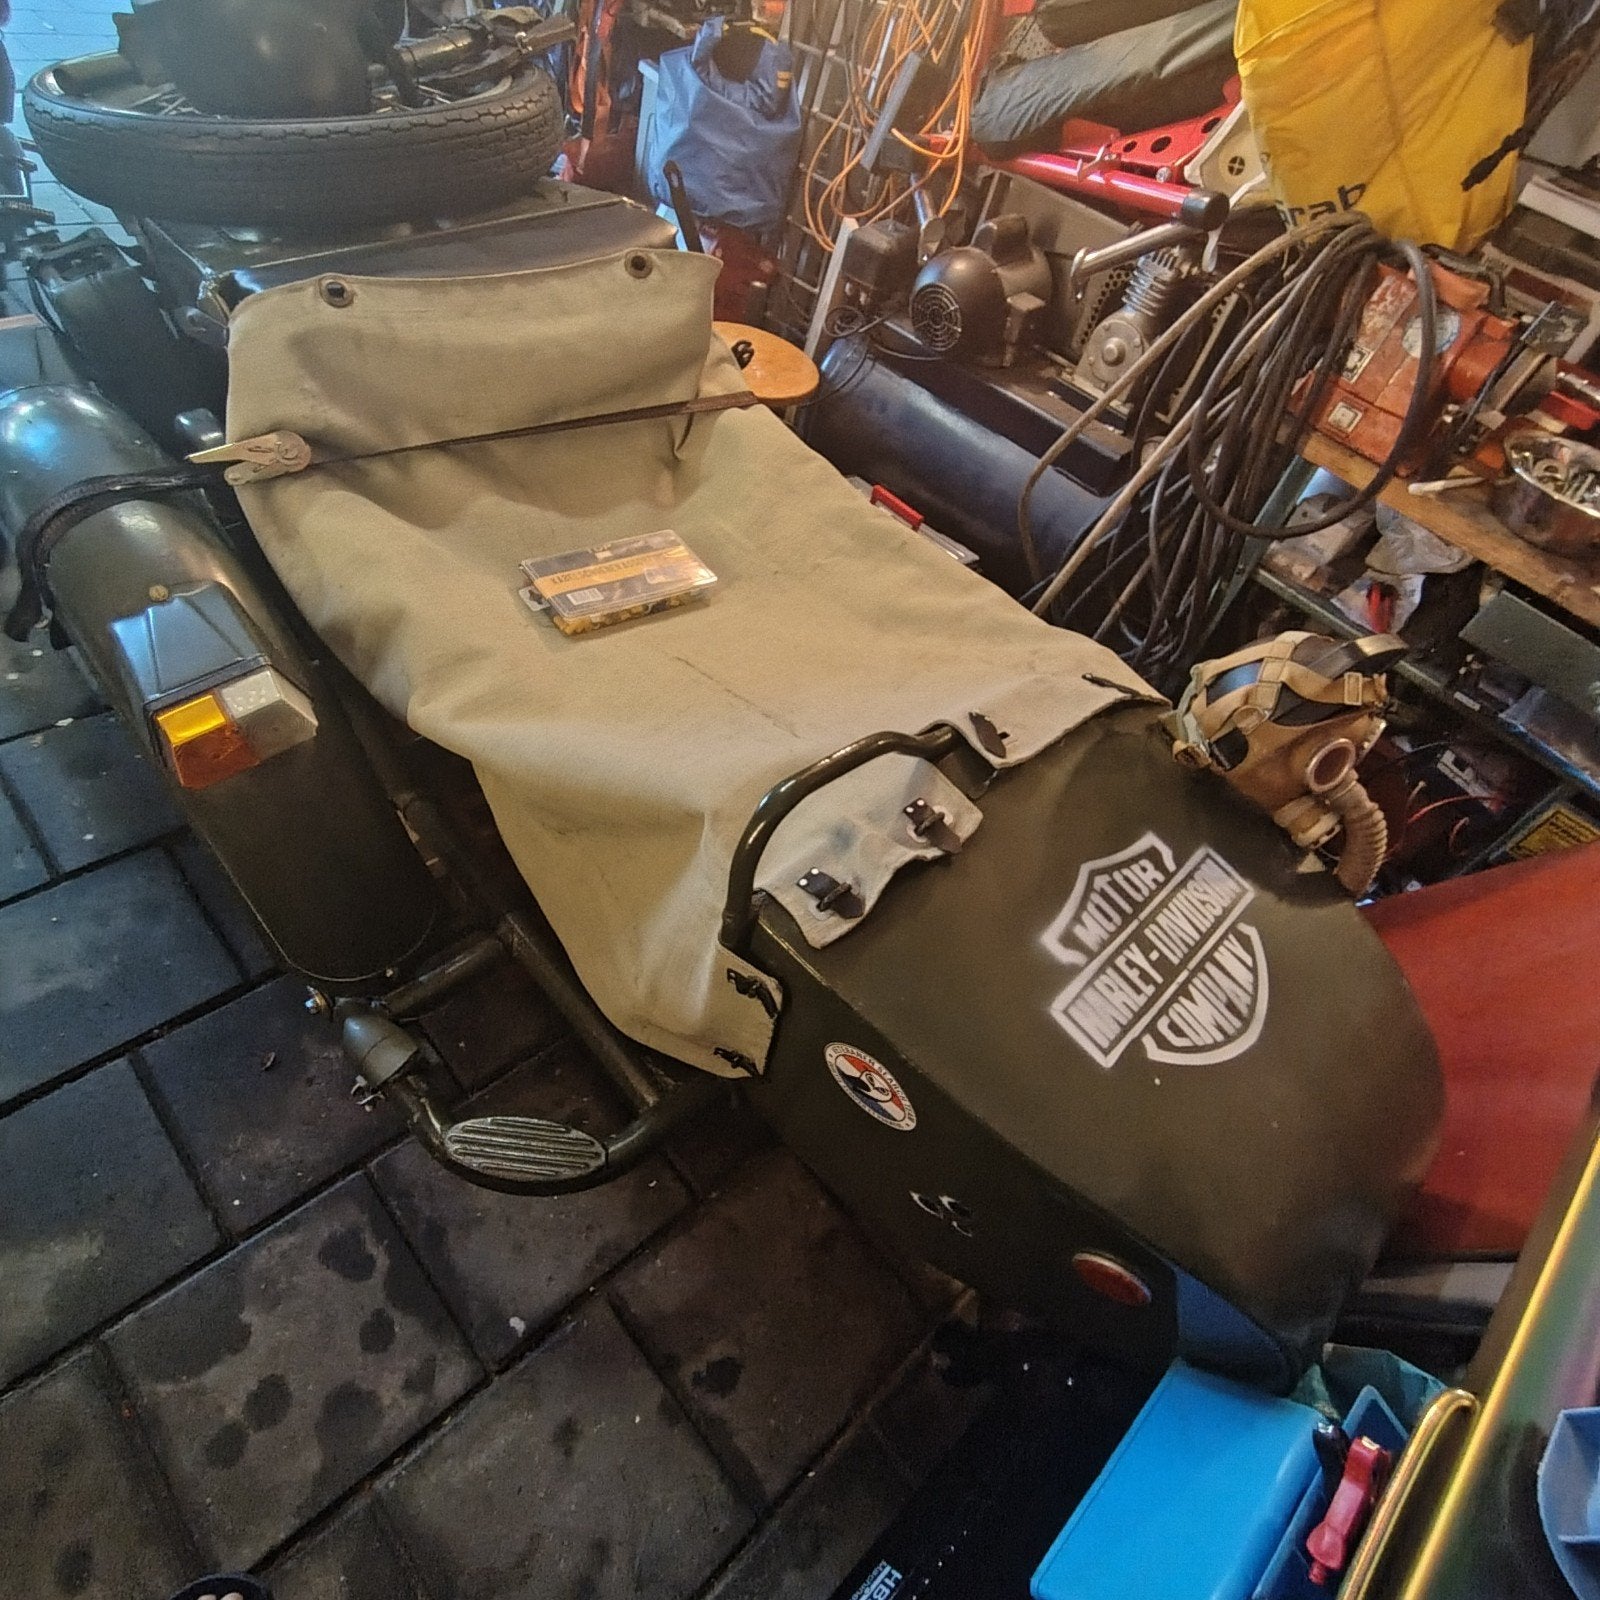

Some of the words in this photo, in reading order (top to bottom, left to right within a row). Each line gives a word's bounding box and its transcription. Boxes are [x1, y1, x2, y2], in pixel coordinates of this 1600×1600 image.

[1072, 858, 1166, 953] MOTOR
[1066, 857, 1243, 1050] HARLEY-DAVIDSON
[1156, 933, 1254, 1048] COMPANY
[849, 1559, 887, 1600] Machine
[870, 1569, 903, 1600] HB
